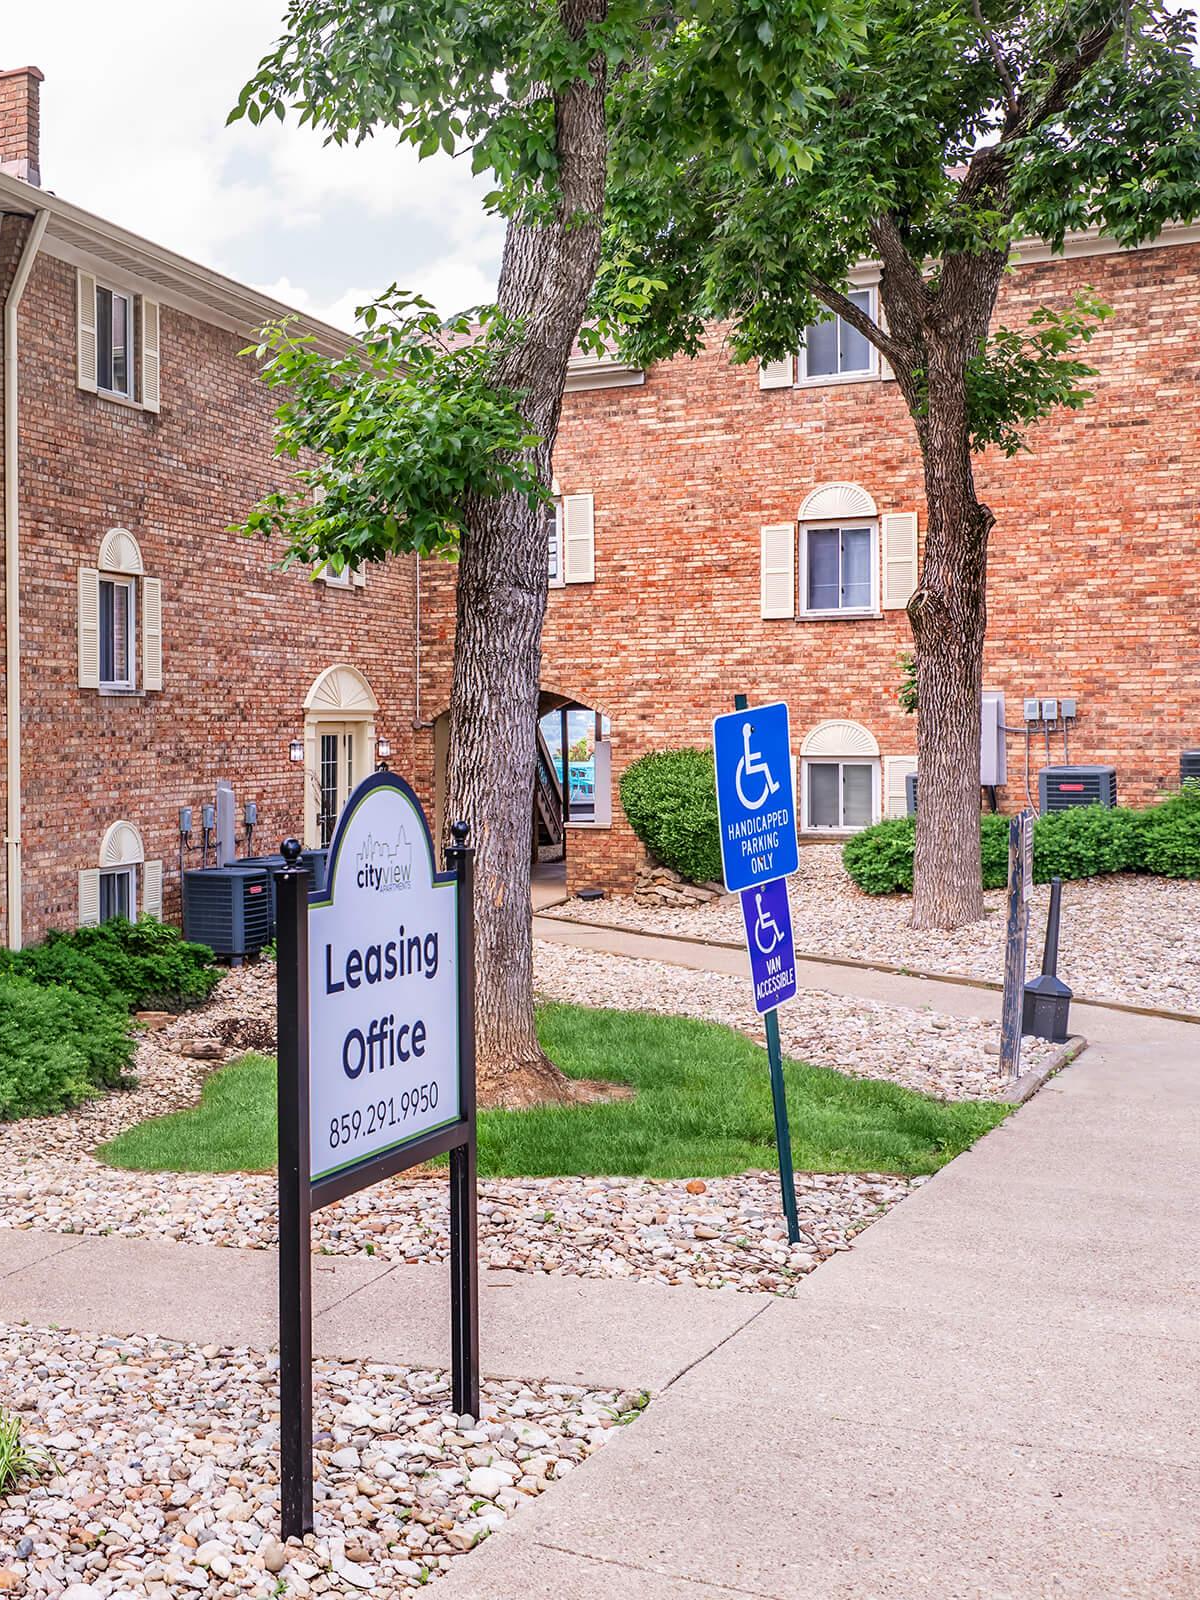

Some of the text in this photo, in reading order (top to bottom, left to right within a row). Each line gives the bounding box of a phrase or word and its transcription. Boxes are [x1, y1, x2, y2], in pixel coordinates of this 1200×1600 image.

[728, 809, 789, 841] HANDICAPPED
[741, 831, 780, 857] PARKING
[357, 860, 411, 891] cityview
[751, 852, 773, 874] ONLY
[326, 925, 439, 995] Leasing
[766, 955, 782, 976] VAN
[757, 967, 795, 1001] ACCESSIBLE
[343, 1014, 427, 1080] Office
[330, 1081, 439, 1149] 859.291.9950
